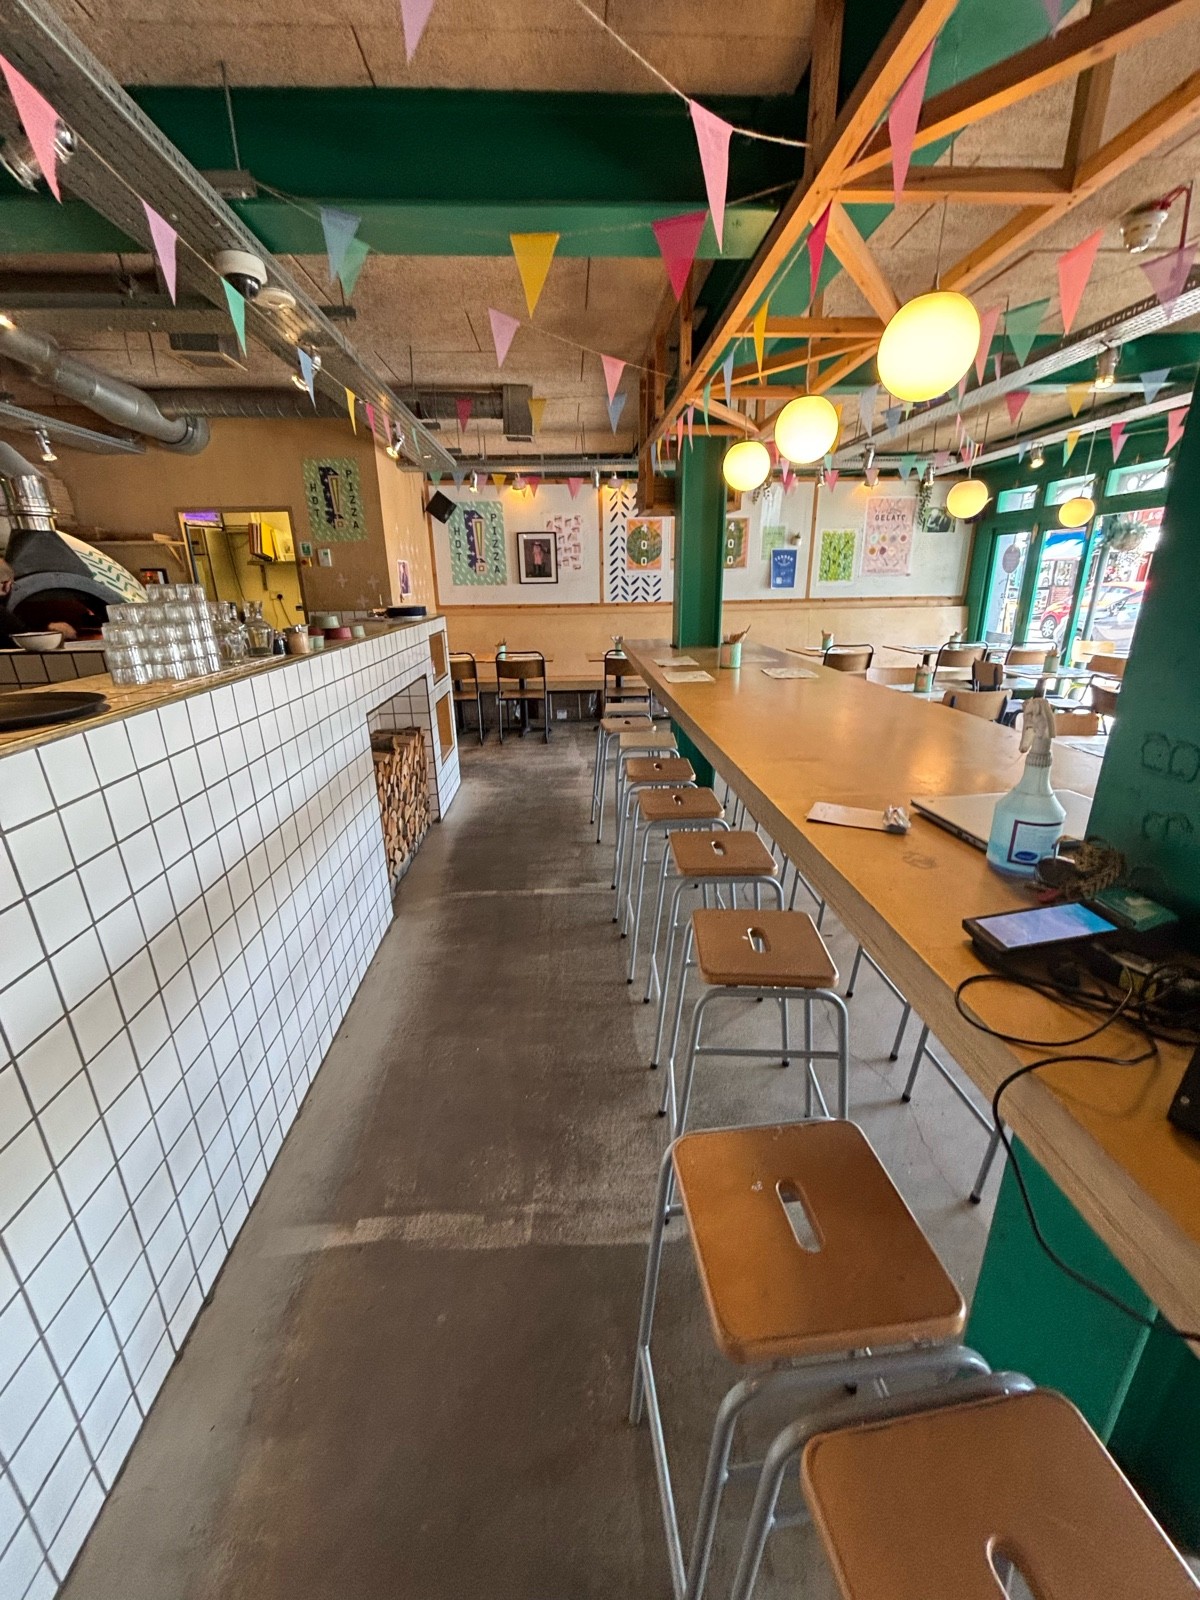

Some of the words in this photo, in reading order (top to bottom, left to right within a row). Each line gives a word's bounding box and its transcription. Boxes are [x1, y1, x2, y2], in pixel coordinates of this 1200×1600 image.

[309, 483, 319, 517] HOT
[345, 469, 360, 529] PIZZA
[453, 527, 463, 561] HOT
[490, 513, 501, 573] PIZZA
[640, 523, 648, 566] 400
[726, 521, 736, 564] 400
